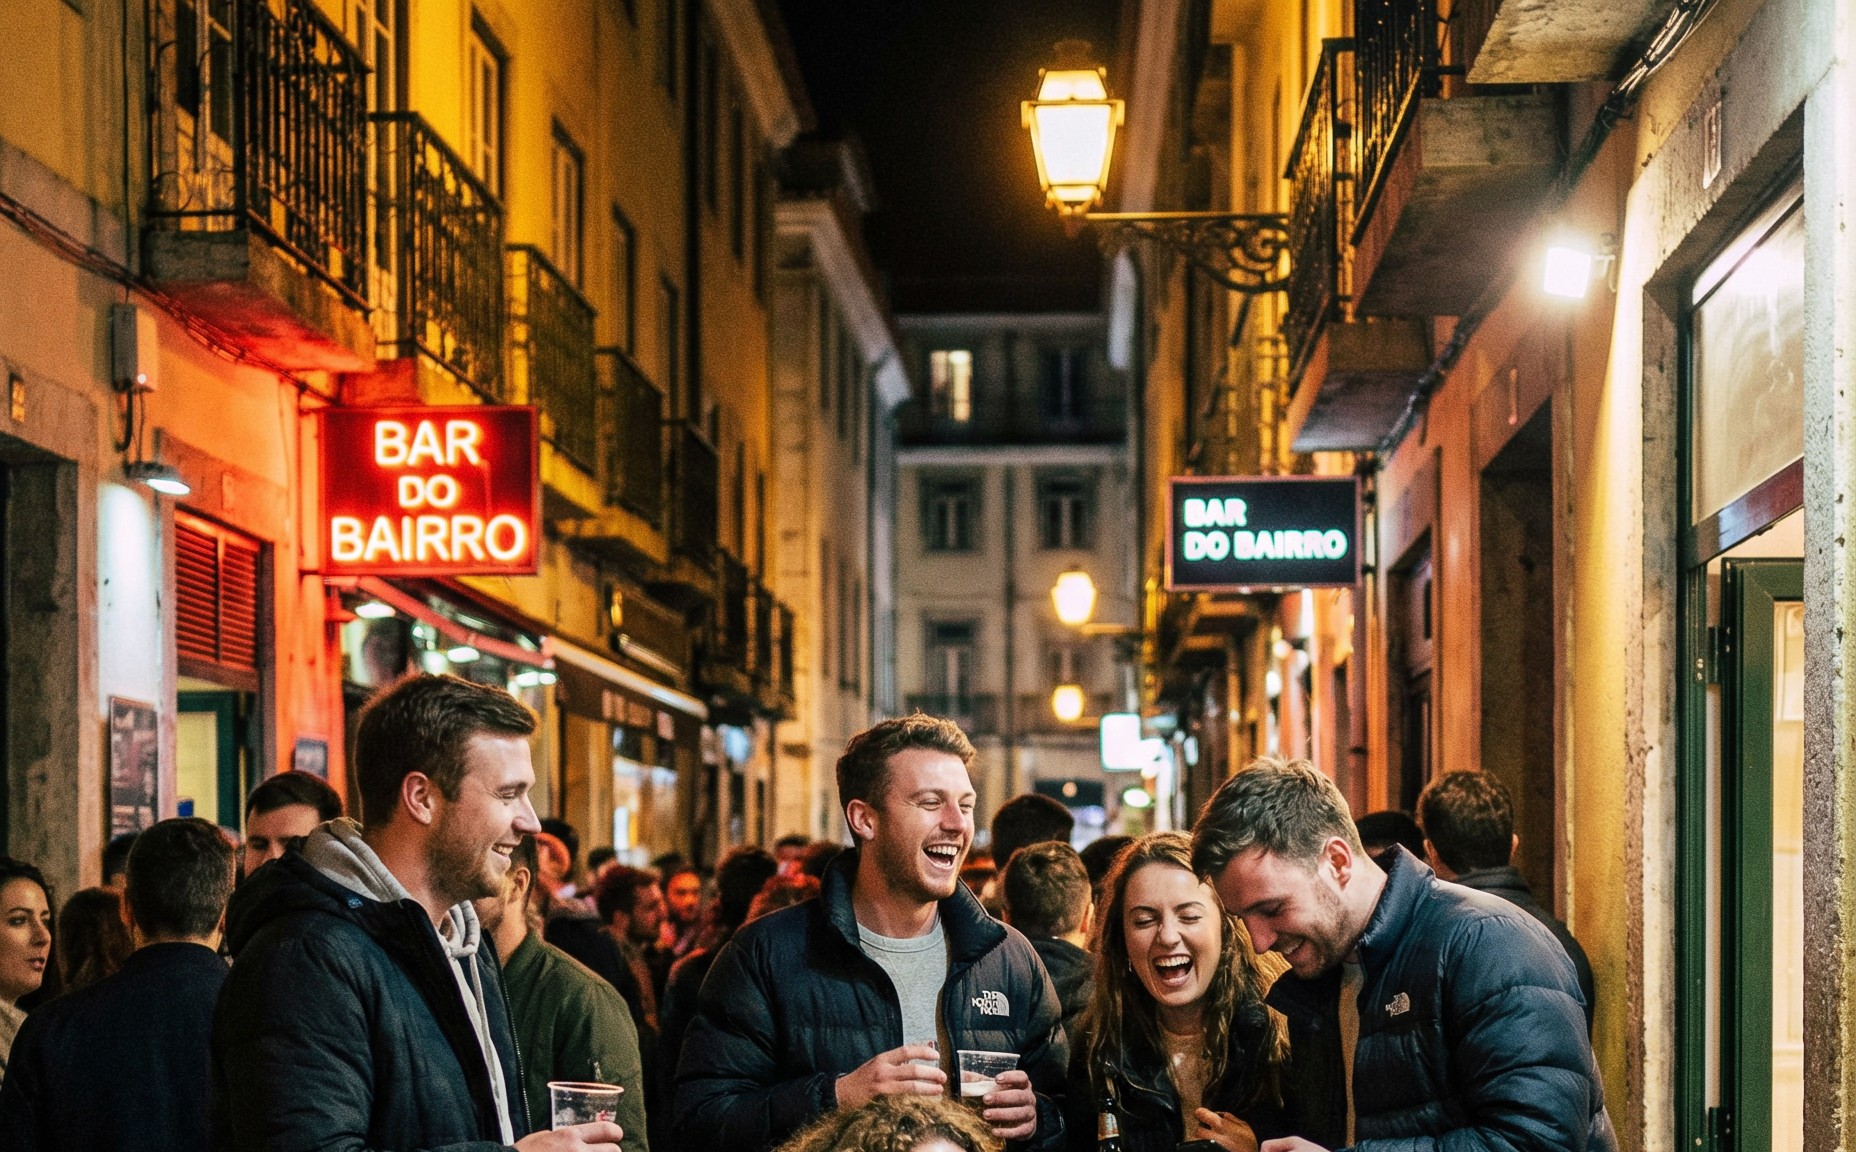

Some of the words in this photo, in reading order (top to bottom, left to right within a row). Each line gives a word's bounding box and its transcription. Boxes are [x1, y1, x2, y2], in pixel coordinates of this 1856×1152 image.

[374, 420, 480, 466] BAR
[398, 474, 457, 508] DO
[1184, 498, 1248, 527] BAR
[331, 514, 526, 562] BAIRRO
[1184, 530, 1230, 561] DO
[1233, 529, 1348, 560] BAIRRO
